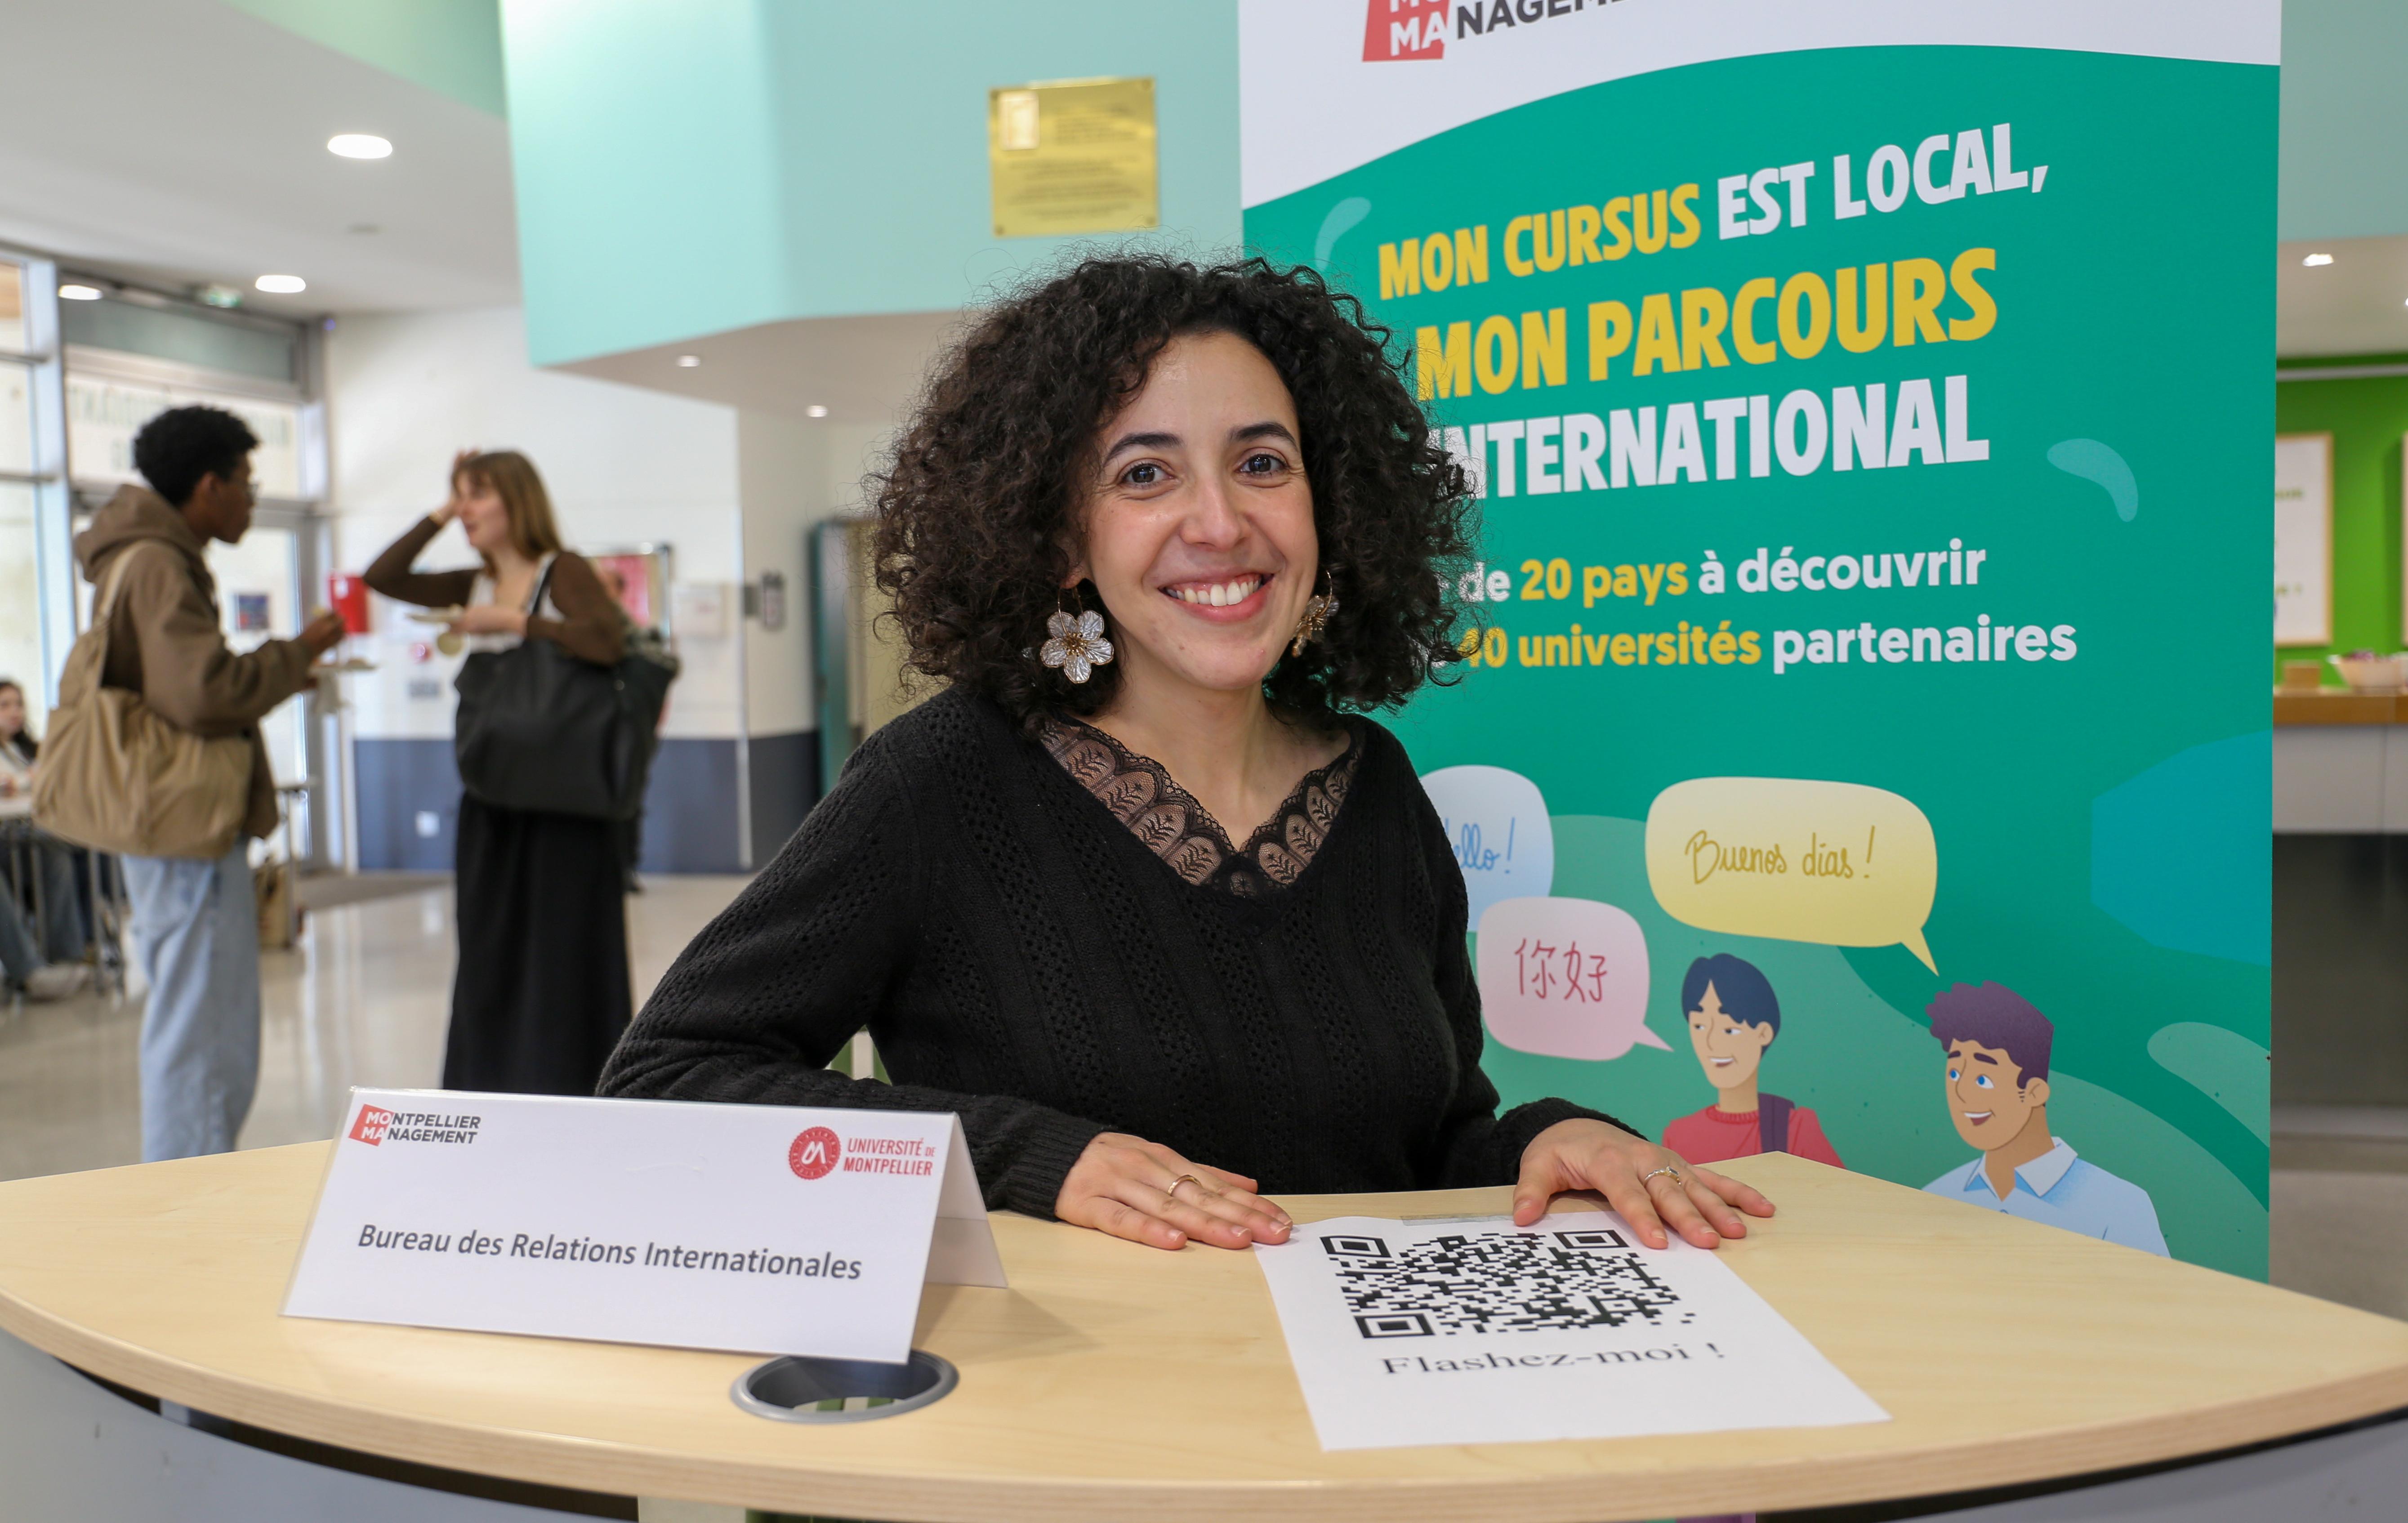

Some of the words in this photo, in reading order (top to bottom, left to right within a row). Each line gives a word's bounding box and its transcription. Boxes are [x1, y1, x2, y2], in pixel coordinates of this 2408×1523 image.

[1378, 225, 1489, 300] MON
[1503, 183, 1701, 277] CURSUS
[1717, 161, 1815, 240] EST
[1833, 123, 2049, 219] LOCAL,
[1416, 308, 1567, 401] MON
[1588, 247, 1998, 381] PARCOURS
[1458, 561, 1511, 602] de
[1520, 558, 1572, 600] 20
[1583, 562, 1689, 608] pays
[1698, 550, 1726, 594] à
[1737, 538, 1986, 592] découvrir
[1518, 620, 1761, 667] universités
[1774, 613, 2077, 674] partenaires
[1685, 830, 1787, 885] Buenos
[1802, 832, 1853, 879] días
[1515, 938, 1607, 1003] 你好
[366, 1111, 481, 1129] MONTPELLIER
[847, 1138, 924, 1156] UNIVERSITÉ
[844, 1157, 933, 1175] MONTPELLIER
[358, 1224, 451, 1252] Bureau
[458, 1229, 504, 1255] des
[511, 1233, 637, 1264] Relations
[644, 1242, 862, 1279] Internationales
[1381, 1343, 1693, 1375] Flashez-moi
[1706, 1342, 1726, 1359] !
